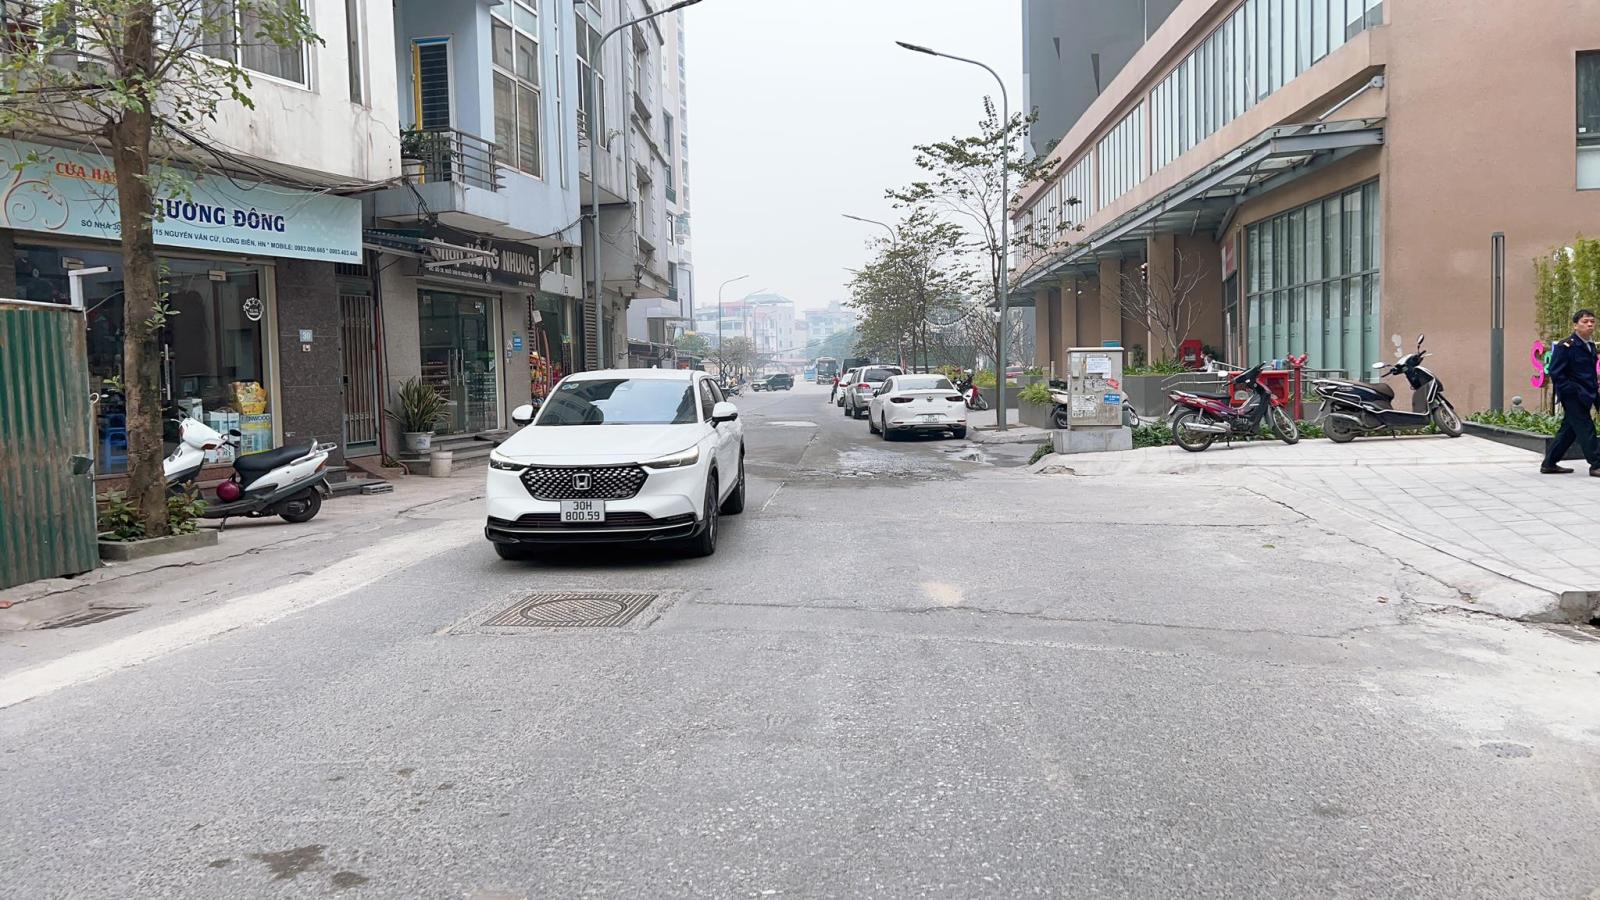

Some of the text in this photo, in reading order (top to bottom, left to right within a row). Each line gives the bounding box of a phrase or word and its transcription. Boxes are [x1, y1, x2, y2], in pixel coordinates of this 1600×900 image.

[232, 207, 285, 232] ĐÔNG
[222, 236, 240, 245] LONG
[502, 250, 536, 276] NHUNG
[573, 501, 593, 511] 30H
[565, 511, 600, 521] 800.59
